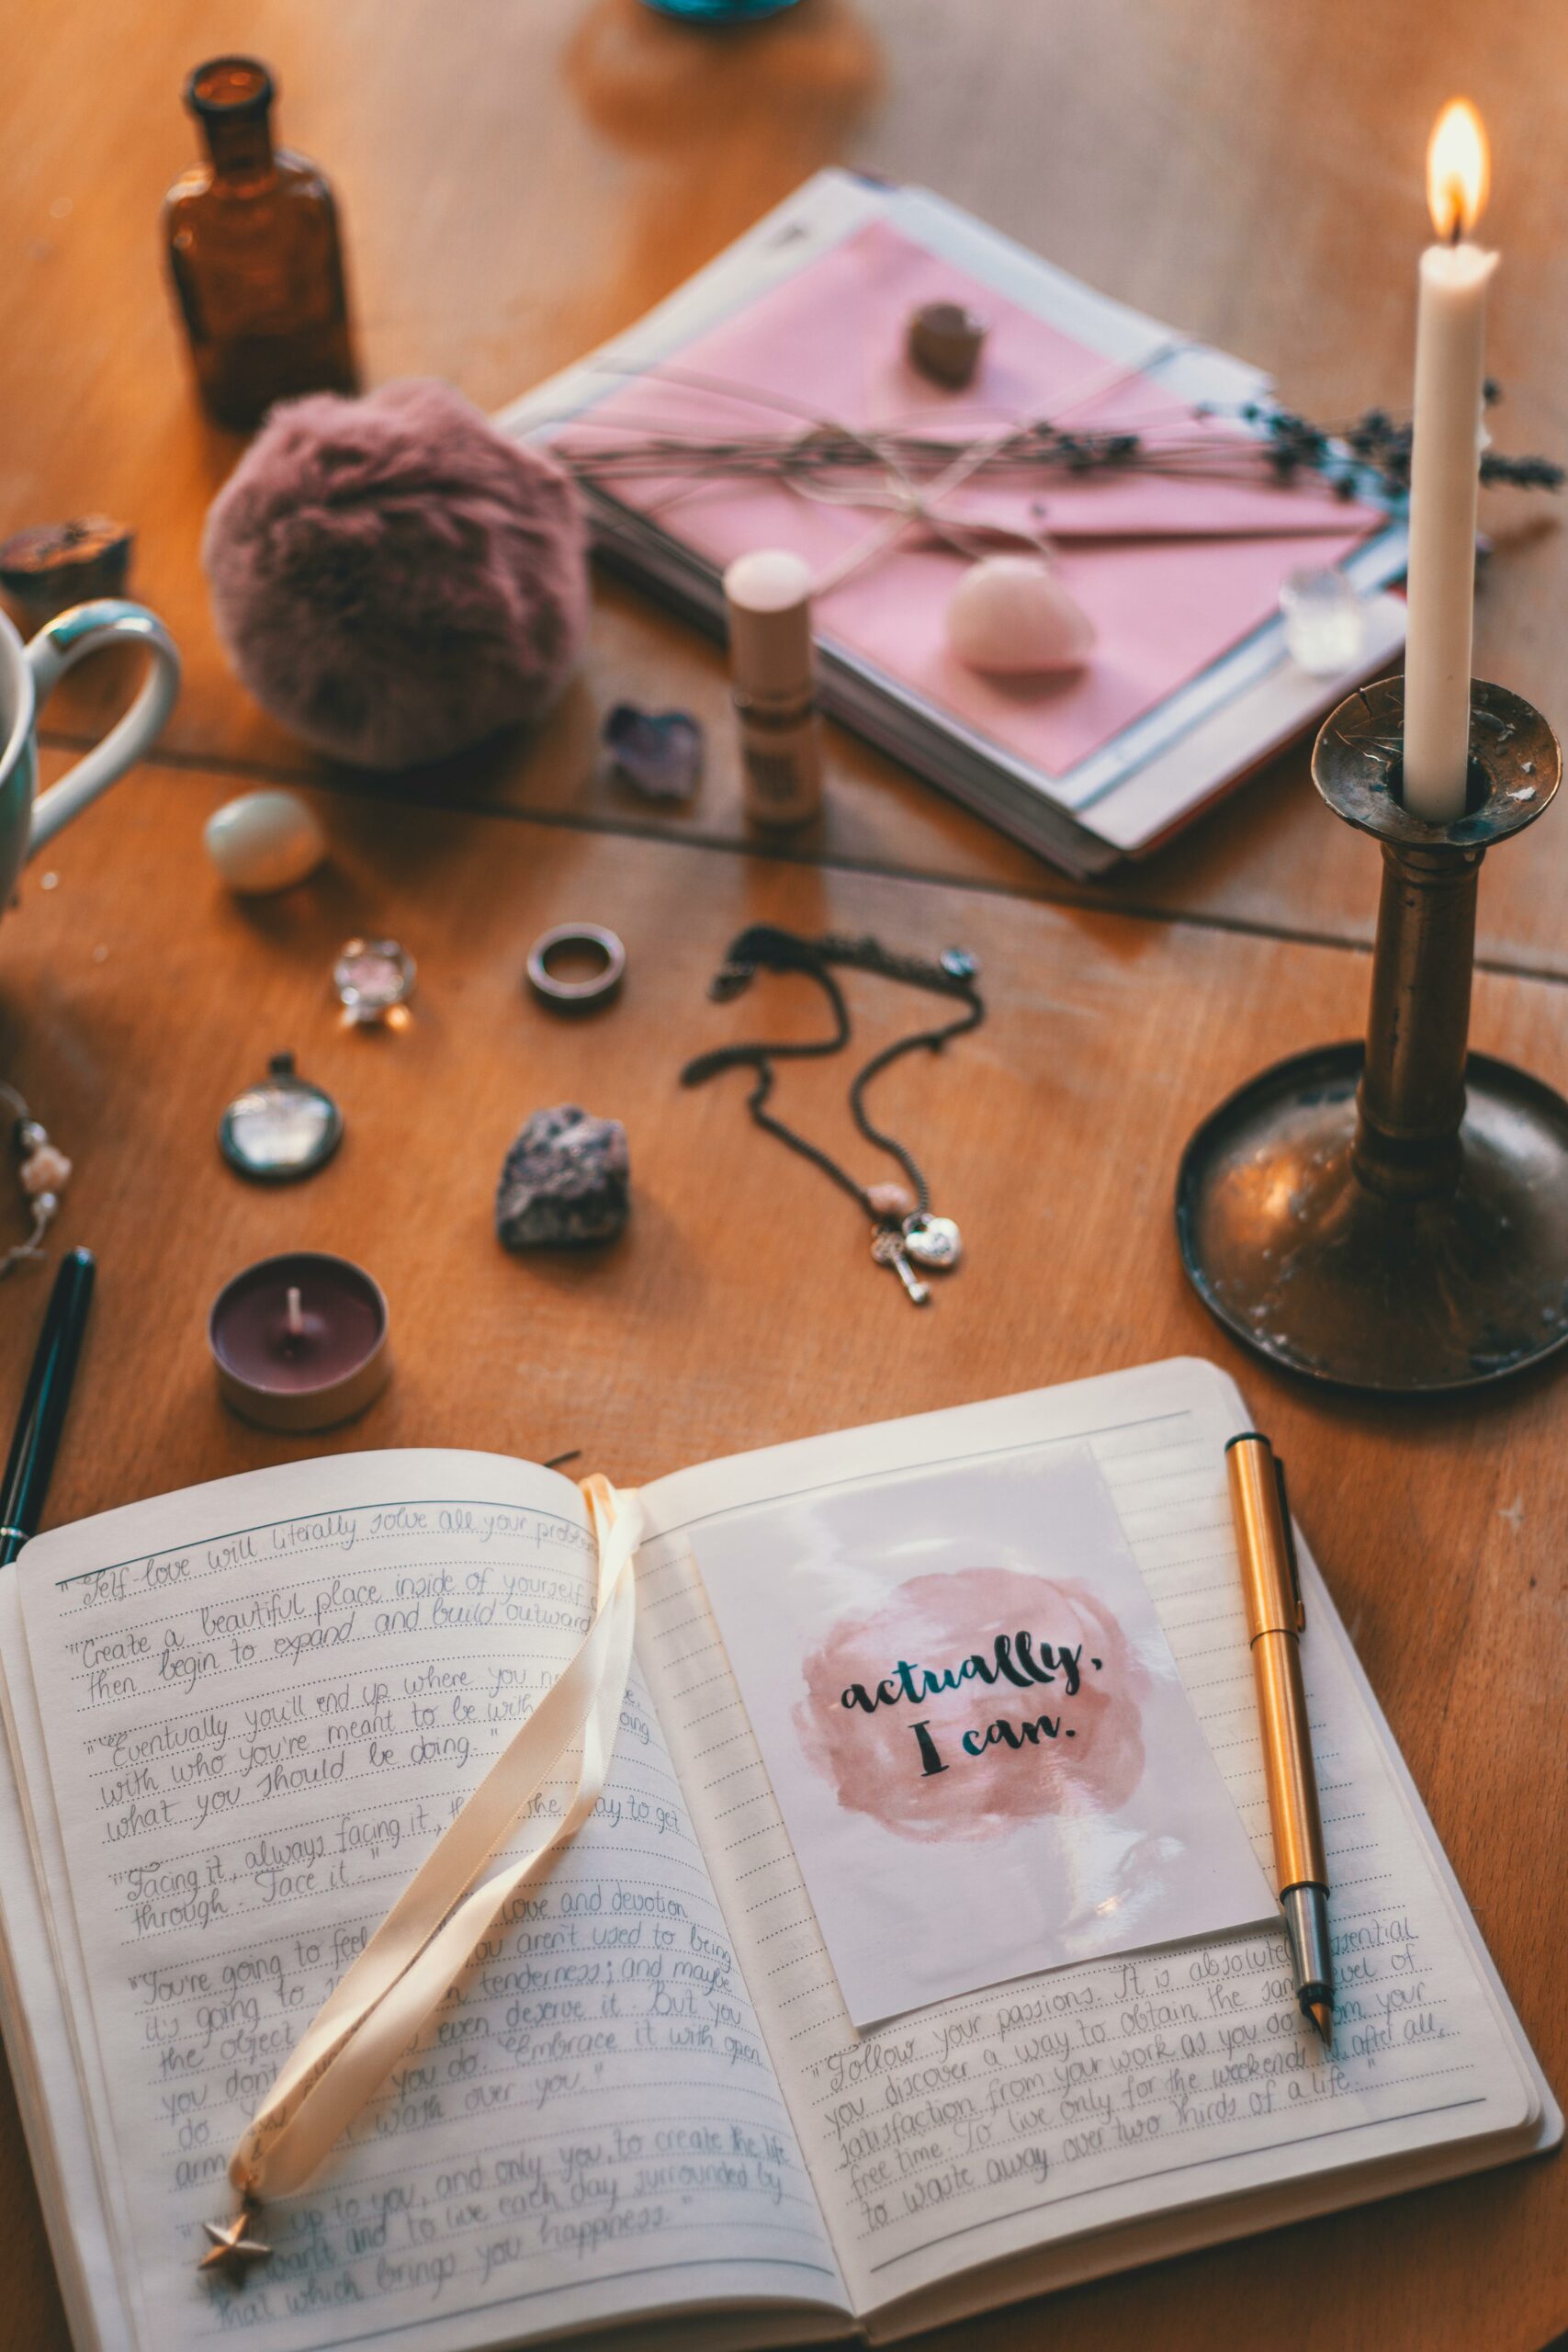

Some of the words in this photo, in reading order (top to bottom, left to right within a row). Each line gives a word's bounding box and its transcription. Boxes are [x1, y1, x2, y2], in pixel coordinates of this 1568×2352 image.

[208, 1536, 257, 1569] will
[369, 1506, 427, 1533] solve
[439, 1509, 476, 1532] all
[483, 1514, 526, 1544] your
[88, 1670, 138, 1703] then
[159, 1651, 220, 1695] begin
[230, 1639, 257, 1665] to
[274, 1611, 355, 1667] expand
[375, 1602, 420, 1634] and
[432, 1597, 497, 1625] build
[164, 1628, 185, 1648] a
[201, 1591, 305, 1637] beautiful
[316, 1579, 382, 1626] place
[395, 1567, 457, 1598] inside
[465, 1566, 494, 1596] of
[502, 1574, 585, 1606] yourself
[101, 1768, 160, 1807] with
[171, 1751, 227, 1784] who
[239, 1733, 309, 1777] you're
[327, 1709, 397, 1745] meant
[412, 1702, 440, 1728] to
[452, 1694, 478, 1722] be
[487, 1692, 535, 1720] with
[244, 1695, 305, 1743] you'll
[316, 1682, 351, 1712] end
[362, 1682, 390, 1716] up
[404, 1665, 474, 1696] where
[488, 1666, 526, 1699] you
[908, 1719, 950, 1777] I
[962, 1713, 1076, 1756] can.
[107, 1799, 182, 1843] what
[193, 1787, 241, 1831] you
[256, 1749, 345, 1797] should
[368, 1741, 399, 1768] be
[244, 1835, 324, 1870] always
[334, 1815, 401, 1853] facing
[594, 1794, 622, 1828] ay
[626, 1794, 649, 1819] to
[655, 1807, 681, 1835] get
[254, 1868, 315, 1903] Face
[144, 2016, 181, 2042] it's
[197, 1996, 259, 2049] going
[276, 1977, 305, 2008] to
[474, 1939, 502, 1962] ou
[515, 1923, 580, 1955] aren't
[592, 1920, 643, 1946] used
[653, 1923, 675, 1948] to
[690, 1924, 733, 1974] being
[221, 1954, 283, 1992] going
[293, 1939, 321, 1966] to
[332, 1926, 368, 1971] feel
[559, 1883, 603, 1912] and
[611, 1882, 690, 1920] devotion
[159, 2047, 205, 2078] the
[220, 2023, 296, 2065] object
[621, 1953, 663, 1978] and
[672, 1959, 734, 1997] maybe
[161, 2085, 209, 2127] you
[436, 2013, 491, 2044] even
[506, 1996, 587, 2027] deserve
[645, 1979, 699, 2016] But
[708, 1998, 742, 2029] you
[391, 2066, 436, 2104] you
[634, 2020, 657, 2047] it
[669, 2022, 716, 2050] with
[724, 2034, 765, 2067] open
[824, 2098, 864, 2142] you
[885, 2062, 968, 2107] discover
[983, 2048, 1000, 2066] a
[1014, 2029, 1070, 2063] way
[1075, 2019, 1106, 2044] to
[1120, 2001, 1197, 2034] obtain
[1207, 1984, 1246, 2014] the
[1391, 1943, 1416, 1973] of
[932, 2016, 981, 2064] your
[1110, 1964, 1145, 2000] It
[1154, 1968, 1170, 1989] is
[374, 2093, 445, 2134] wash
[463, 2081, 516, 2111] over
[839, 2098, 976, 2169] satisfaction
[986, 2073, 1044, 2115] from
[1055, 2056, 1101, 2098] your
[1110, 2032, 1177, 2071] work
[1180, 2031, 1206, 2058] as
[1219, 2022, 1258, 2059] you
[1267, 2012, 1295, 2034] do
[1378, 1982, 1427, 2022] your
[851, 2160, 893, 2203] free
[953, 2113, 993, 2155] To
[1007, 2106, 1054, 2134] live
[1059, 2086, 1112, 2126] only
[1122, 2075, 1156, 2111] for
[1166, 2068, 1198, 2096] the
[1351, 2023, 1393, 2058] after
[290, 2209, 323, 2242] up
[333, 2194, 361, 2220] to
[435, 2159, 482, 2199] and
[495, 2152, 543, 2186] only
[613, 2125, 642, 2157] to
[654, 2126, 723, 2154] create
[729, 2124, 756, 2159] the
[861, 2199, 889, 2233] to
[902, 2164, 975, 2213] waste
[986, 2145, 1050, 2185] away
[1062, 2131, 1104, 2162] over
[1115, 2111, 1163, 2144] two
[1168, 2091, 1237, 2126] thirds
[1247, 2078, 1279, 2113] of
[1287, 2079, 1304, 2100] a
[345, 2220, 388, 2255] and
[407, 2212, 436, 2240] to
[445, 2201, 488, 2232] live
[498, 2180, 559, 2218] each
[570, 2170, 618, 2214] day
[633, 2159, 748, 2196] surrounded
[757, 2161, 783, 2206] by
[285, 2270, 364, 2315] which
[376, 2255, 456, 2301] brings
[476, 2236, 522, 2286] you
